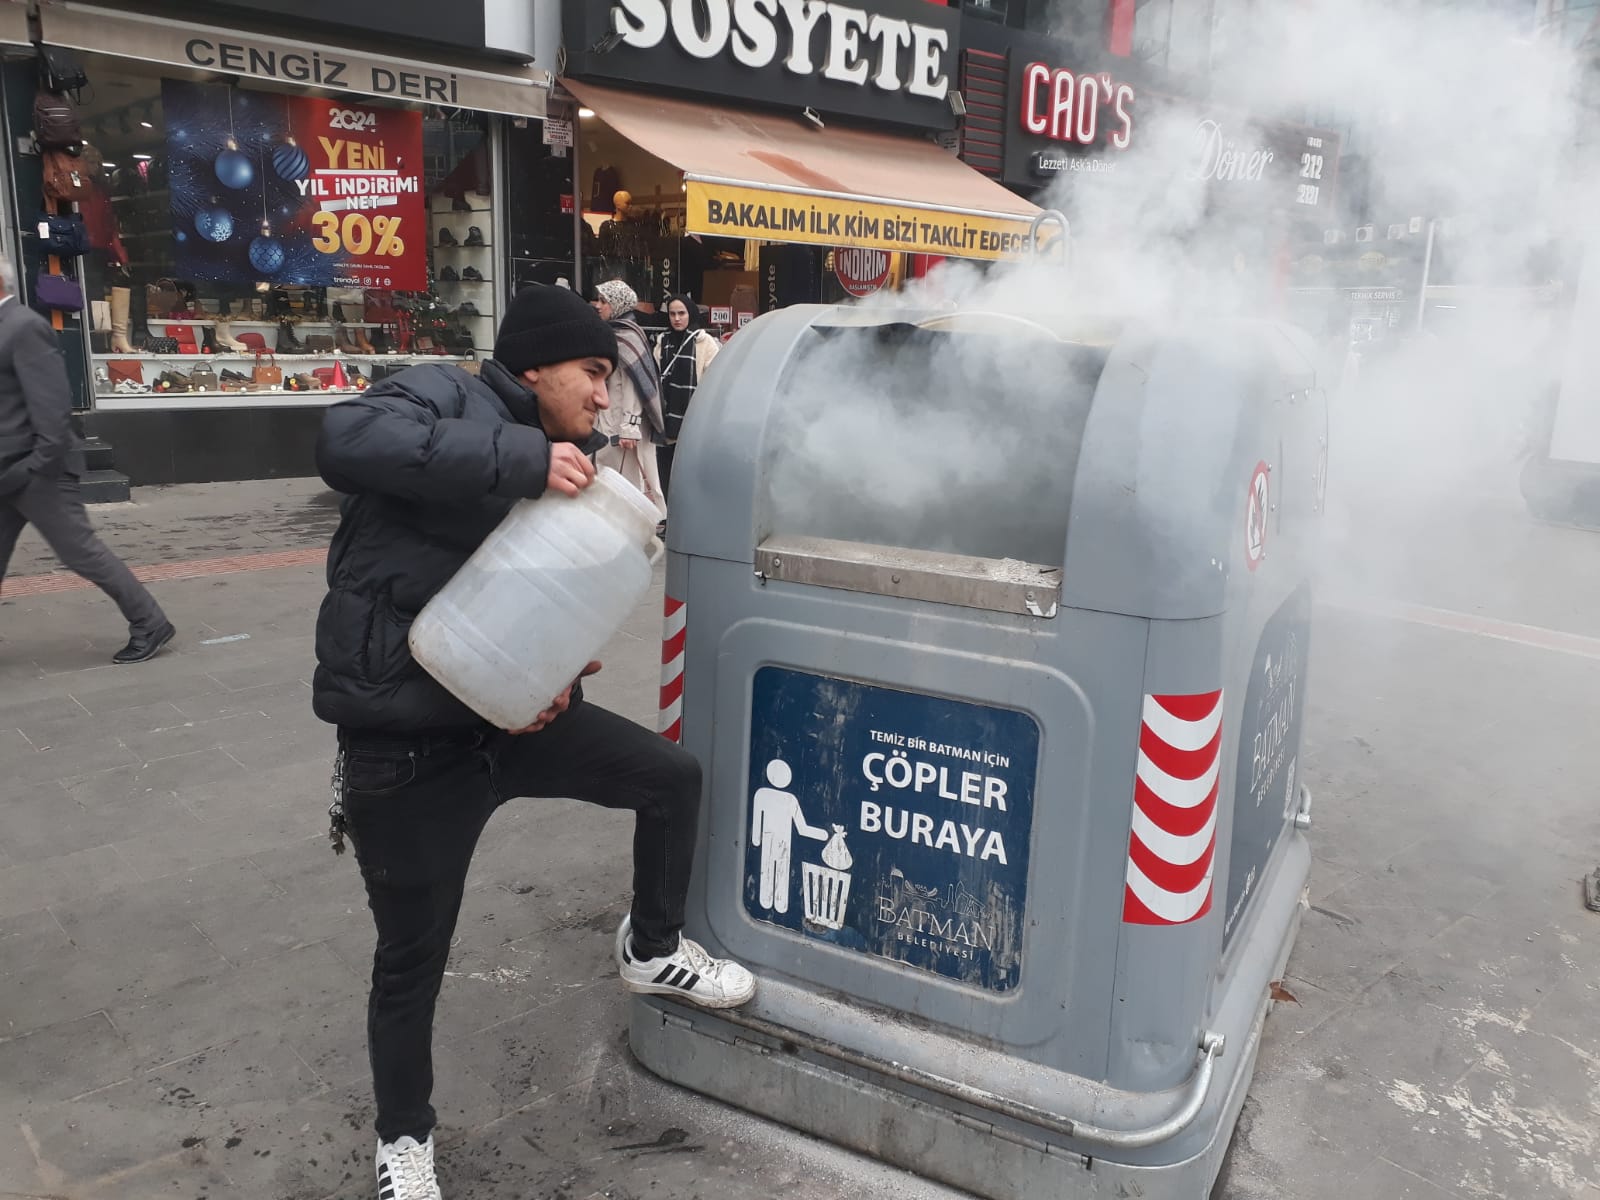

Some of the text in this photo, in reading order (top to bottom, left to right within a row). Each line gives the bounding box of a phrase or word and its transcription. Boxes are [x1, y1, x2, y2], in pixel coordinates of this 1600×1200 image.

[185, 39, 458, 103] CENGİZ DERİ
[614, 0, 949, 100] SOSYETE
[329, 107, 376, 132] 2024
[1024, 63, 1135, 149] CAO'S
[317, 135, 386, 170] YENİ
[1184, 119, 1275, 181] Döner
[295, 179, 329, 196] YIL
[346, 195, 379, 210] NET
[311, 210, 405, 257] 30%
[708, 199, 806, 233] BAKALIM
[810, 205, 840, 236] İLK
[844, 210, 879, 239] KİM
[883, 215, 917, 243] BİZİ
[920, 222, 978, 249] TAKLİT
[713, 312, 728, 321] 200
[740, 317, 751, 326] 15
[870, 730, 1010, 768] TEMİZ BİR BATMAN İÇİN
[862, 749, 1008, 812] ÇÖPLER
[860, 800, 1008, 865] BURAYA
[877, 895, 995, 951] BATMAN
